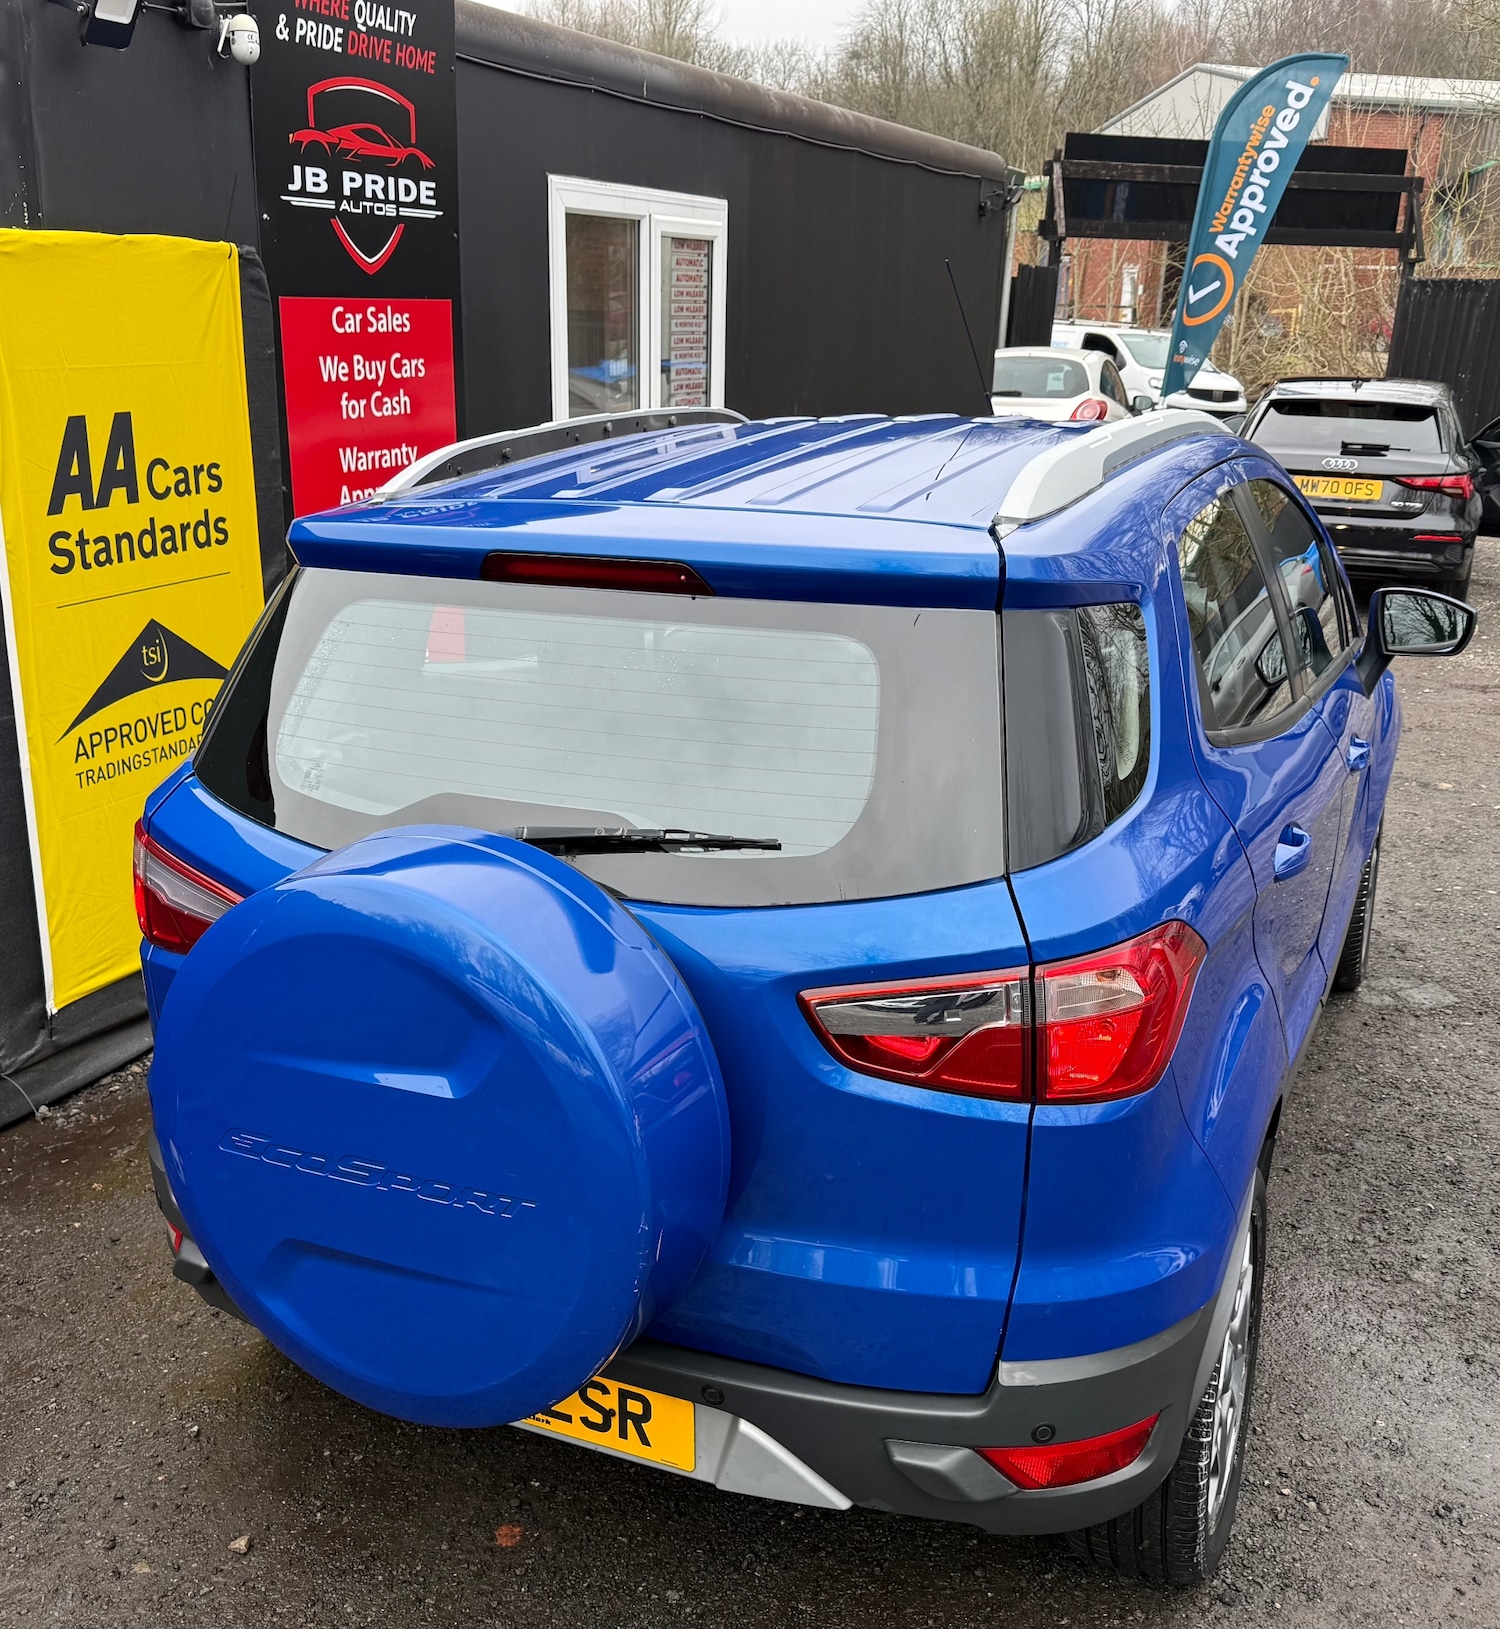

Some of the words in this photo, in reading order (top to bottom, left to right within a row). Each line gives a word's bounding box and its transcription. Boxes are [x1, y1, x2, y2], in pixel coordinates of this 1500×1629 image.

[354, 0, 417, 37] QUALITY
[275, 13, 290, 42] &
[295, 17, 344, 53] PRIDE
[347, 30, 393, 64] DRIVE
[395, 42, 437, 75] HOME
[1209, 104, 1276, 233] Warrantywise
[287, 164, 329, 195] JB
[341, 170, 437, 206] PRIDE
[339, 200, 397, 217] AUTOS
[675, 257, 704, 267] AUTOMATIC
[675, 273, 704, 283] AUTOMATIC
[674, 289, 684, 298] LOW
[685, 289, 704, 298] MILEAGE
[674, 305, 684, 313] LOW
[685, 305, 704, 313] MILEAGE
[331, 306, 362, 334] Car
[366, 305, 411, 333] Sales
[673, 336, 684, 345] LOW
[685, 335, 704, 345] MILEAGE
[318, 355, 349, 383] We
[353, 354, 386, 387] Buy
[390, 353, 426, 379] Cars
[340, 391, 366, 420] for
[370, 388, 411, 418] Cash
[46, 411, 139, 517] AA
[146, 456, 223, 501] Cars
[338, 442, 418, 474] Warranty
[1300, 478, 1340, 494] MW70
[1344, 481, 1374, 497] OFS
[48, 508, 229, 576] Standards
[141, 639, 163, 668] tsi
[74, 706, 187, 764] APPROVED
